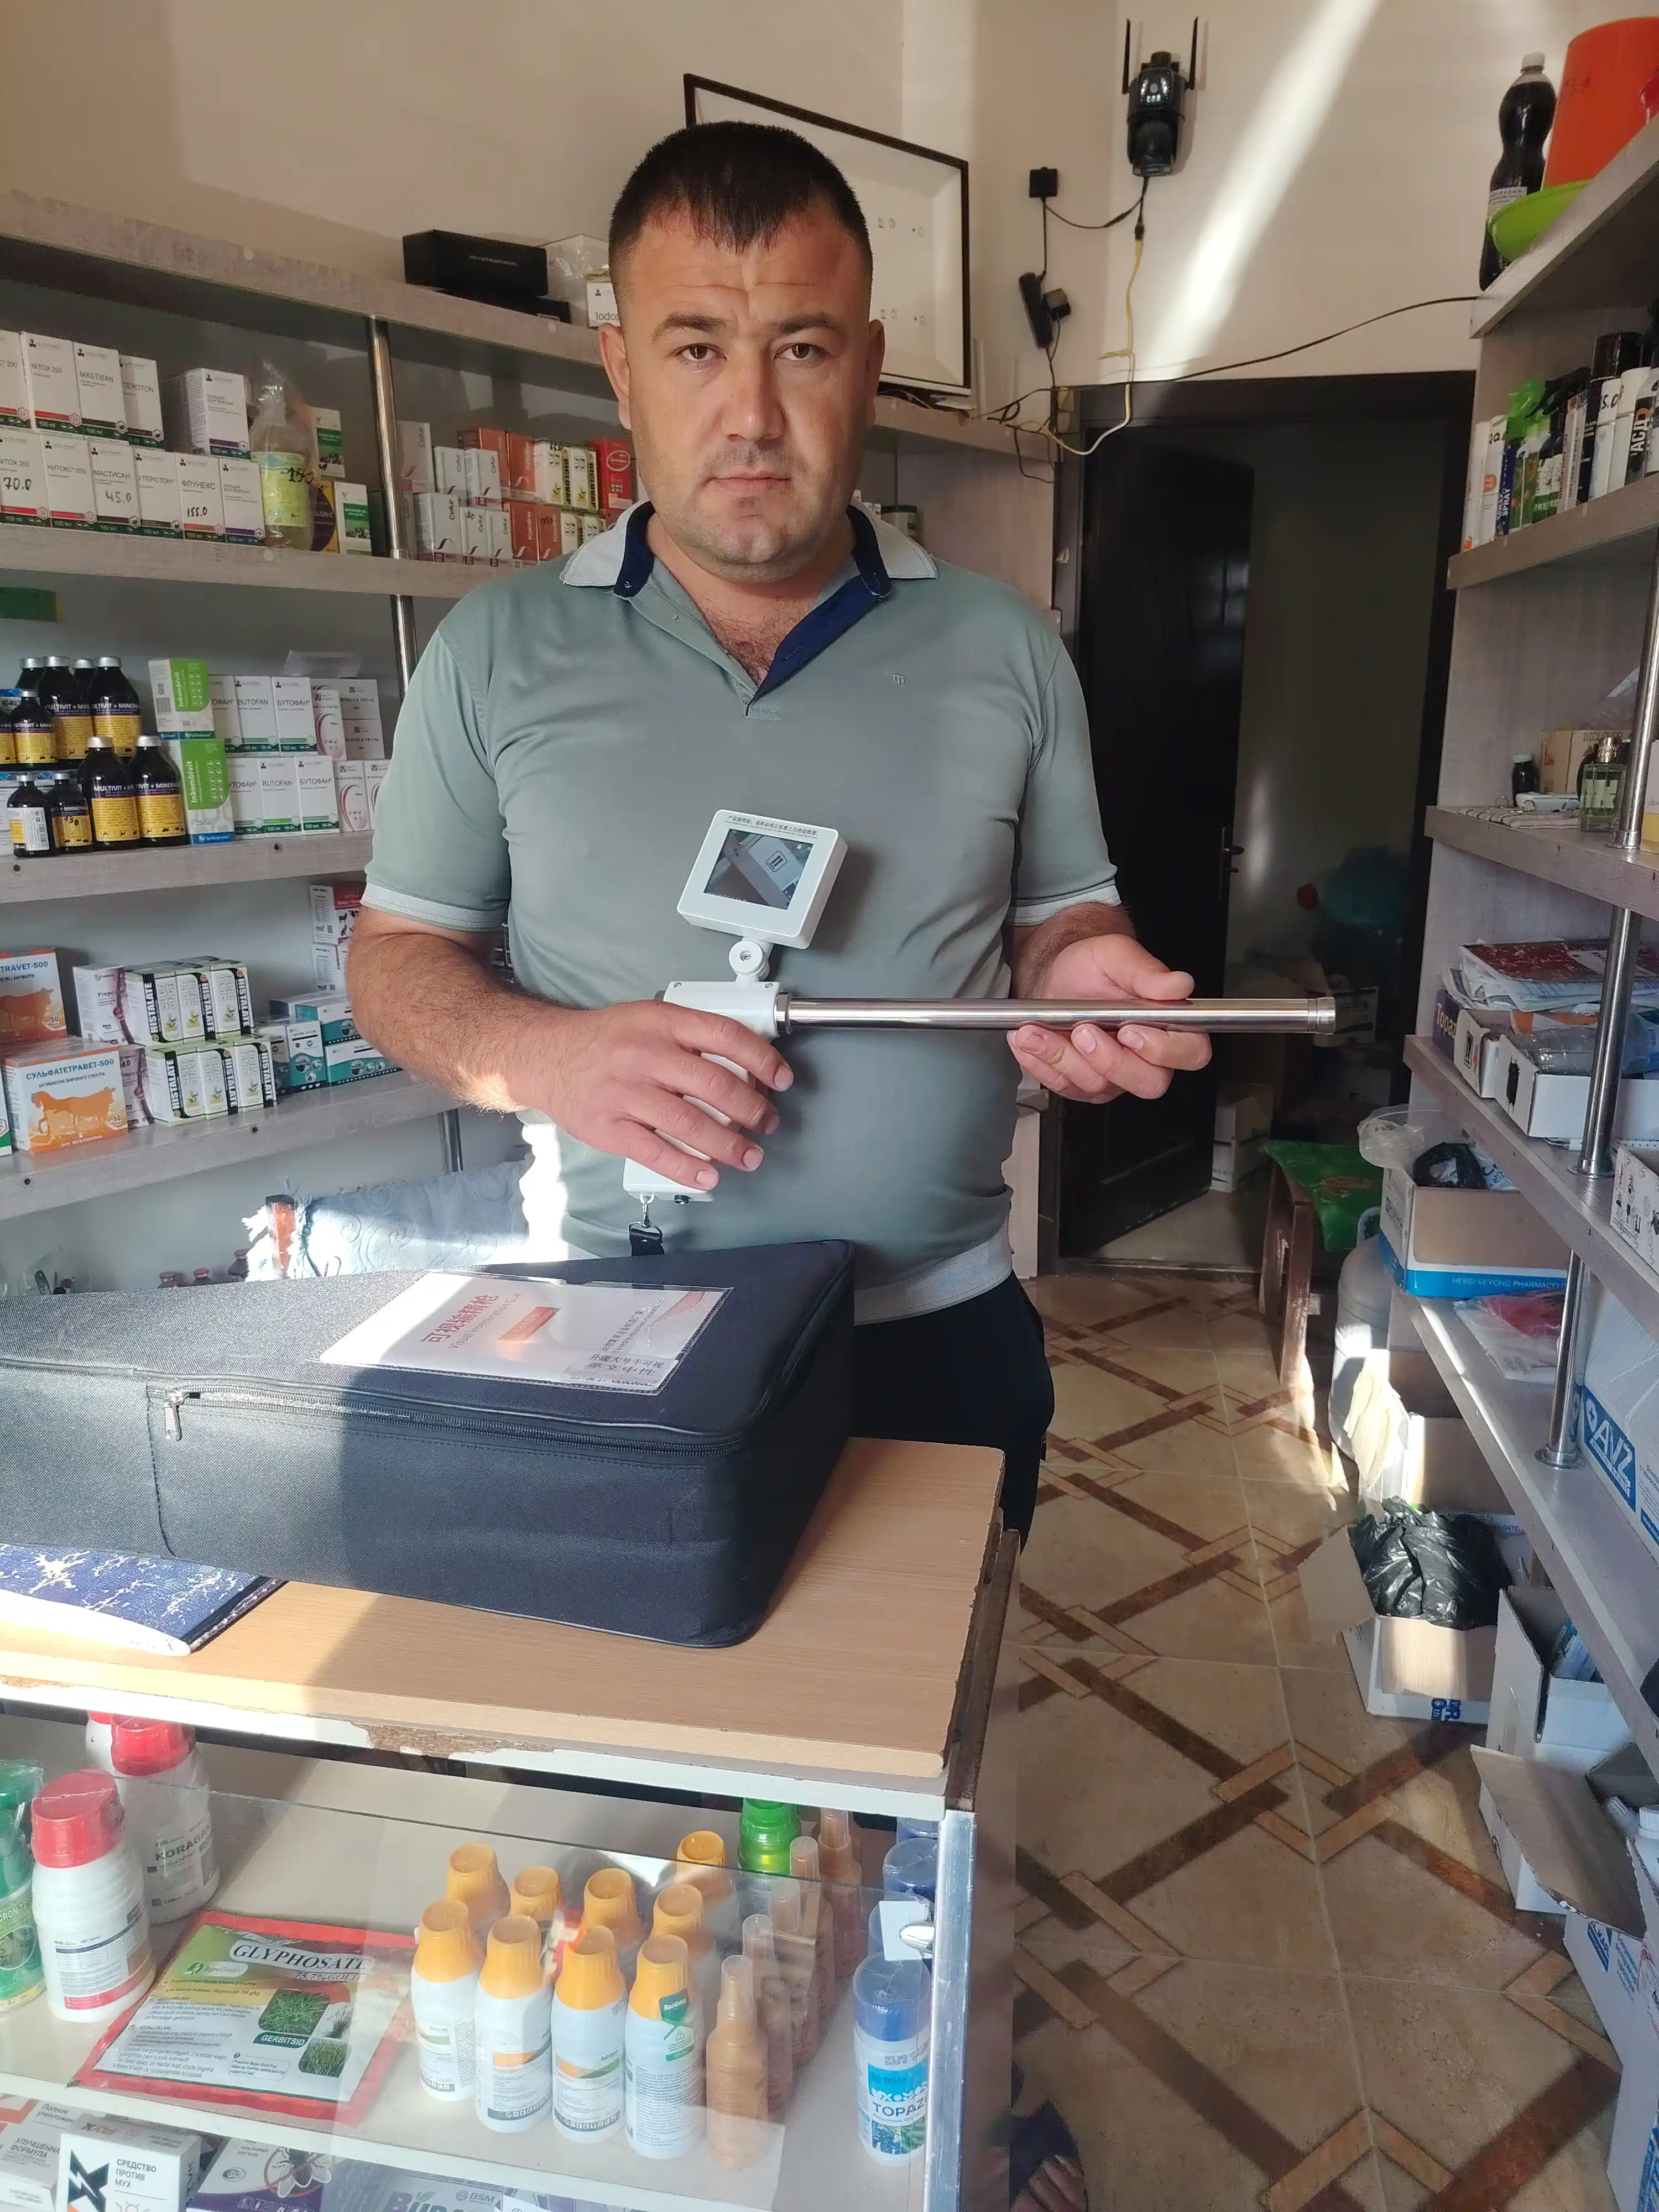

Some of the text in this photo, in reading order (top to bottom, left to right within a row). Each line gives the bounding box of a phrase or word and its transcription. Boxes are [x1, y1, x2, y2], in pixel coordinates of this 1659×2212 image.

[32, 363, 51, 372] NITOX
[80, 371, 114, 383] MASTISAN
[122, 382, 154, 393] TEROTON
[93, 469, 131, 479] МАСТИСАН
[3, 477, 32, 491] 70.0
[181, 480, 216, 489] ФЛУНЕКС
[105, 491, 132, 504] 45.0
[187, 507, 208, 518] 155.0
[93, 784, 123, 792] MULTIVIT
[144, 982, 159, 1034] HISTALATE
[201, 982, 215, 1033] HISTALATE
[237, 978, 251, 1027] HISTALATE
[26, 1058, 114, 1081] СУЛЬФАТЕТРАВЕТ-500
[225, 1057, 237, 1108] HISTALATE
[260, 1052, 273, 1101] HISTALATE
[38, 1079, 65, 1088] АНТИБИОТИК
[166, 1058, 179, 1110] HISTALATE
[1478, 1279, 1511, 1287] VEYONG
[420, 1294, 499, 1343] 可视输精枪
[447, 1333, 473, 1349] Visual
[469, 1302, 510, 1333] Insemination
[505, 1292, 524, 1306] Gun
[1593, 1418, 1632, 1483] AVZ
[233, 1943, 368, 1970] GLYPHOSATE
[663, 1997, 687, 2011] Rainbow
[261, 2034, 305, 2046] GERBITSID
[42, 2103, 70, 2115] Полное
[36, 2111, 76, 2124] уничтожен
[10, 2144, 48, 2159] ФОРМУЛА
[15, 2137, 60, 2155] УЛУЧШЕННА
[117, 2158, 157, 2173] СРЕДСТВО
[116, 2168, 145, 2181] ПРОТИВ
[114, 2178, 132, 2188] МУХ
[469, 2193, 495, 2203] BSM
